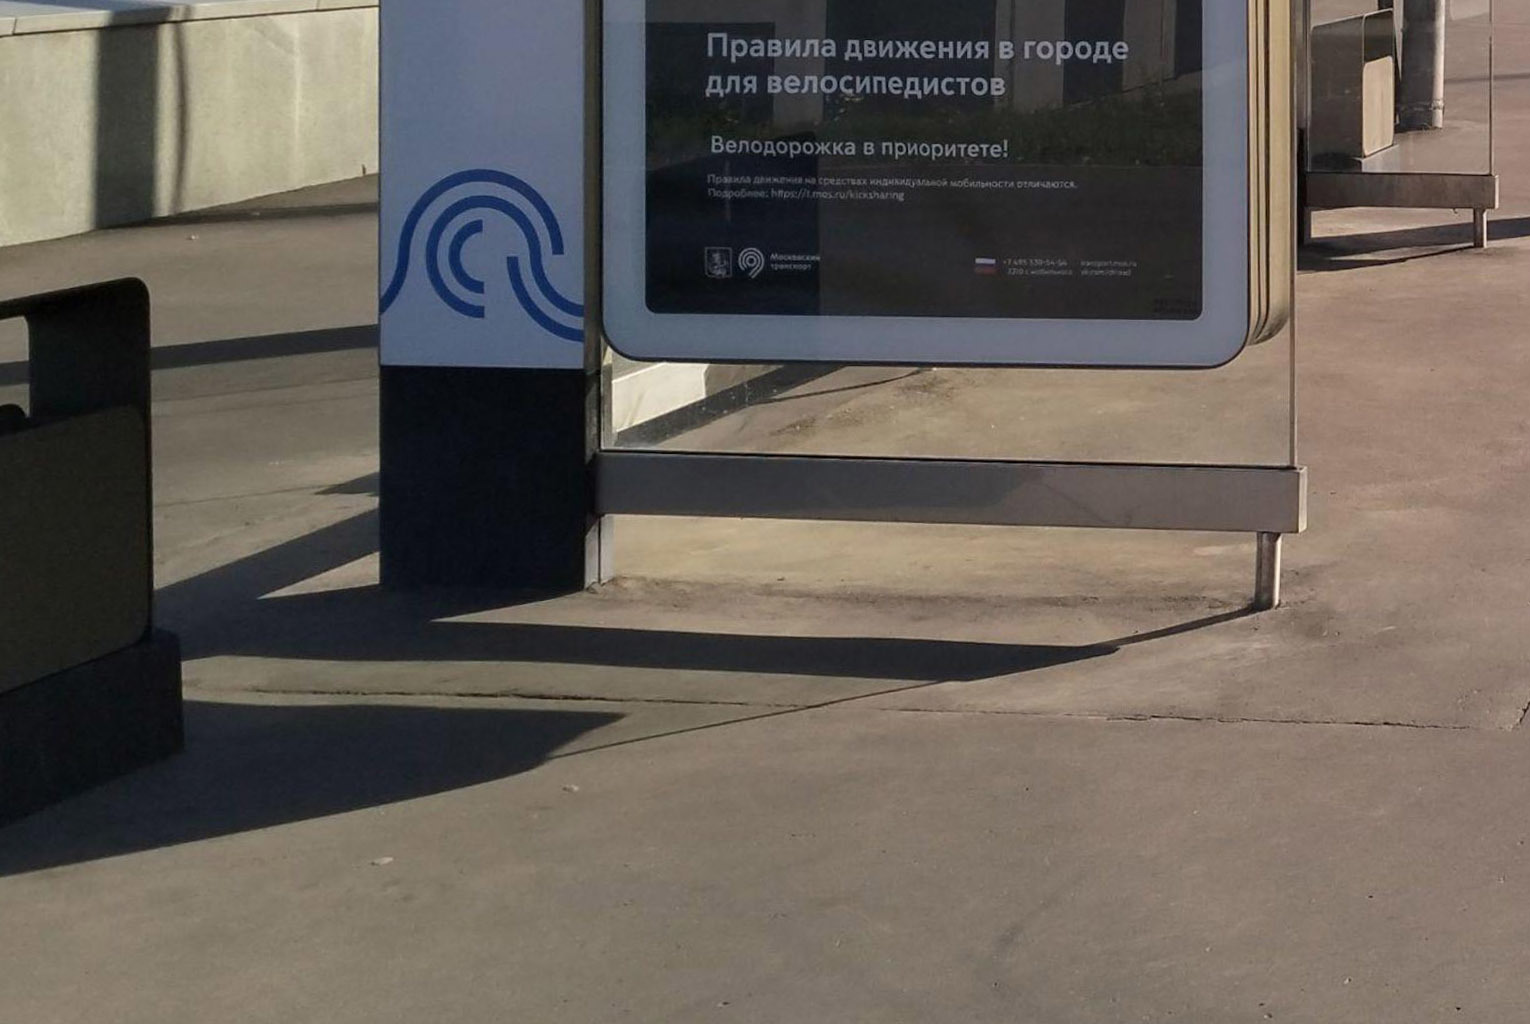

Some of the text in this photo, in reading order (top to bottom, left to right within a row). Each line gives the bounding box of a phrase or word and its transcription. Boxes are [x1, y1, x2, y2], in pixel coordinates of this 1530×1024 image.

[707, 33, 1129, 65] Правила движения в городе
[705, 75, 1006, 100] для велосипедистов
[711, 135, 1009, 161] Велодорожка в приоритете!
[707, 175, 751, 185] Правила
[818, 177, 866, 187] средствах
[950, 179, 1014, 189] мобильности
